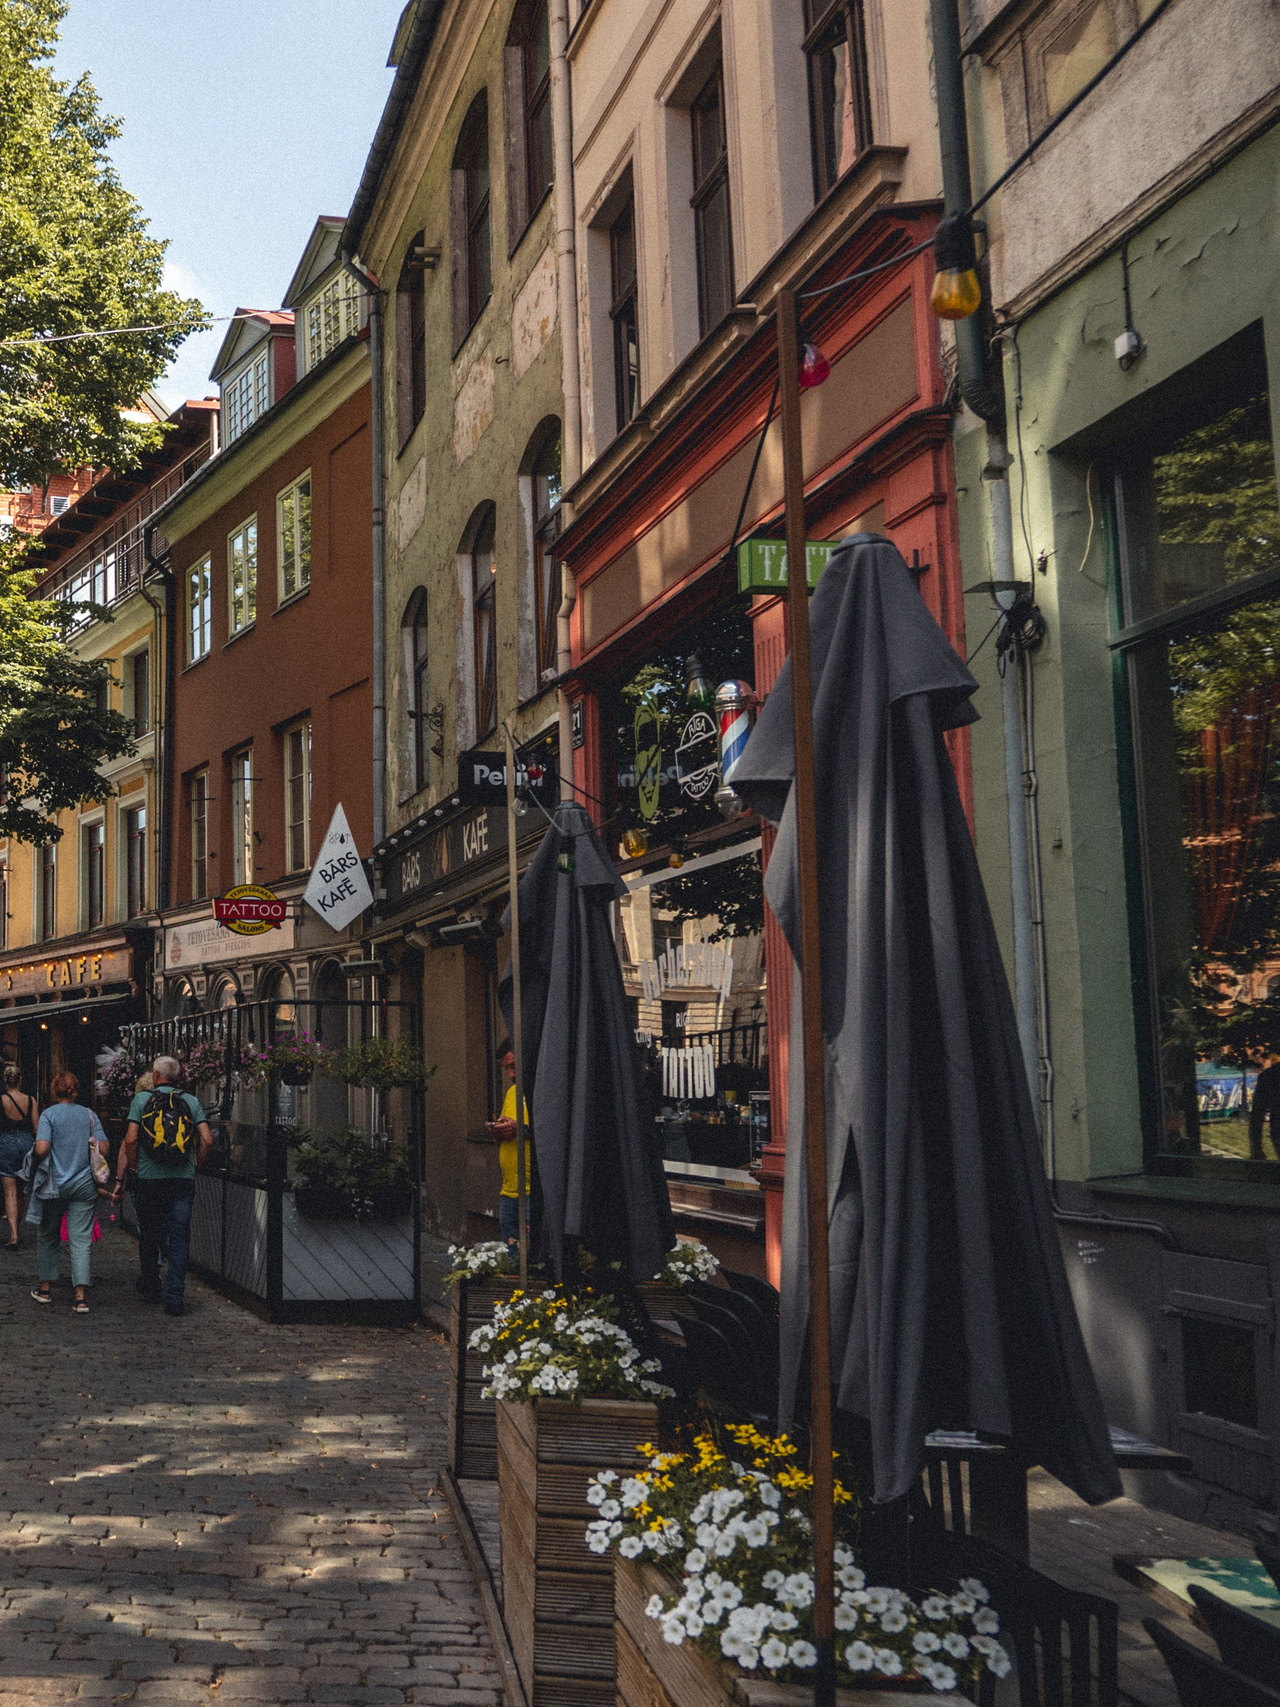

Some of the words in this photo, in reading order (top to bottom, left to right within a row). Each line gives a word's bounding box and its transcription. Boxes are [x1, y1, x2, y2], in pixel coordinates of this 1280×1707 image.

[319, 851, 358, 884] BĀRS
[220, 902, 282, 917] TATTOO
[317, 877, 357, 912] KAFĒ
[46, 958, 102, 988] CAFE
[661, 1043, 715, 1099] TATTOO
